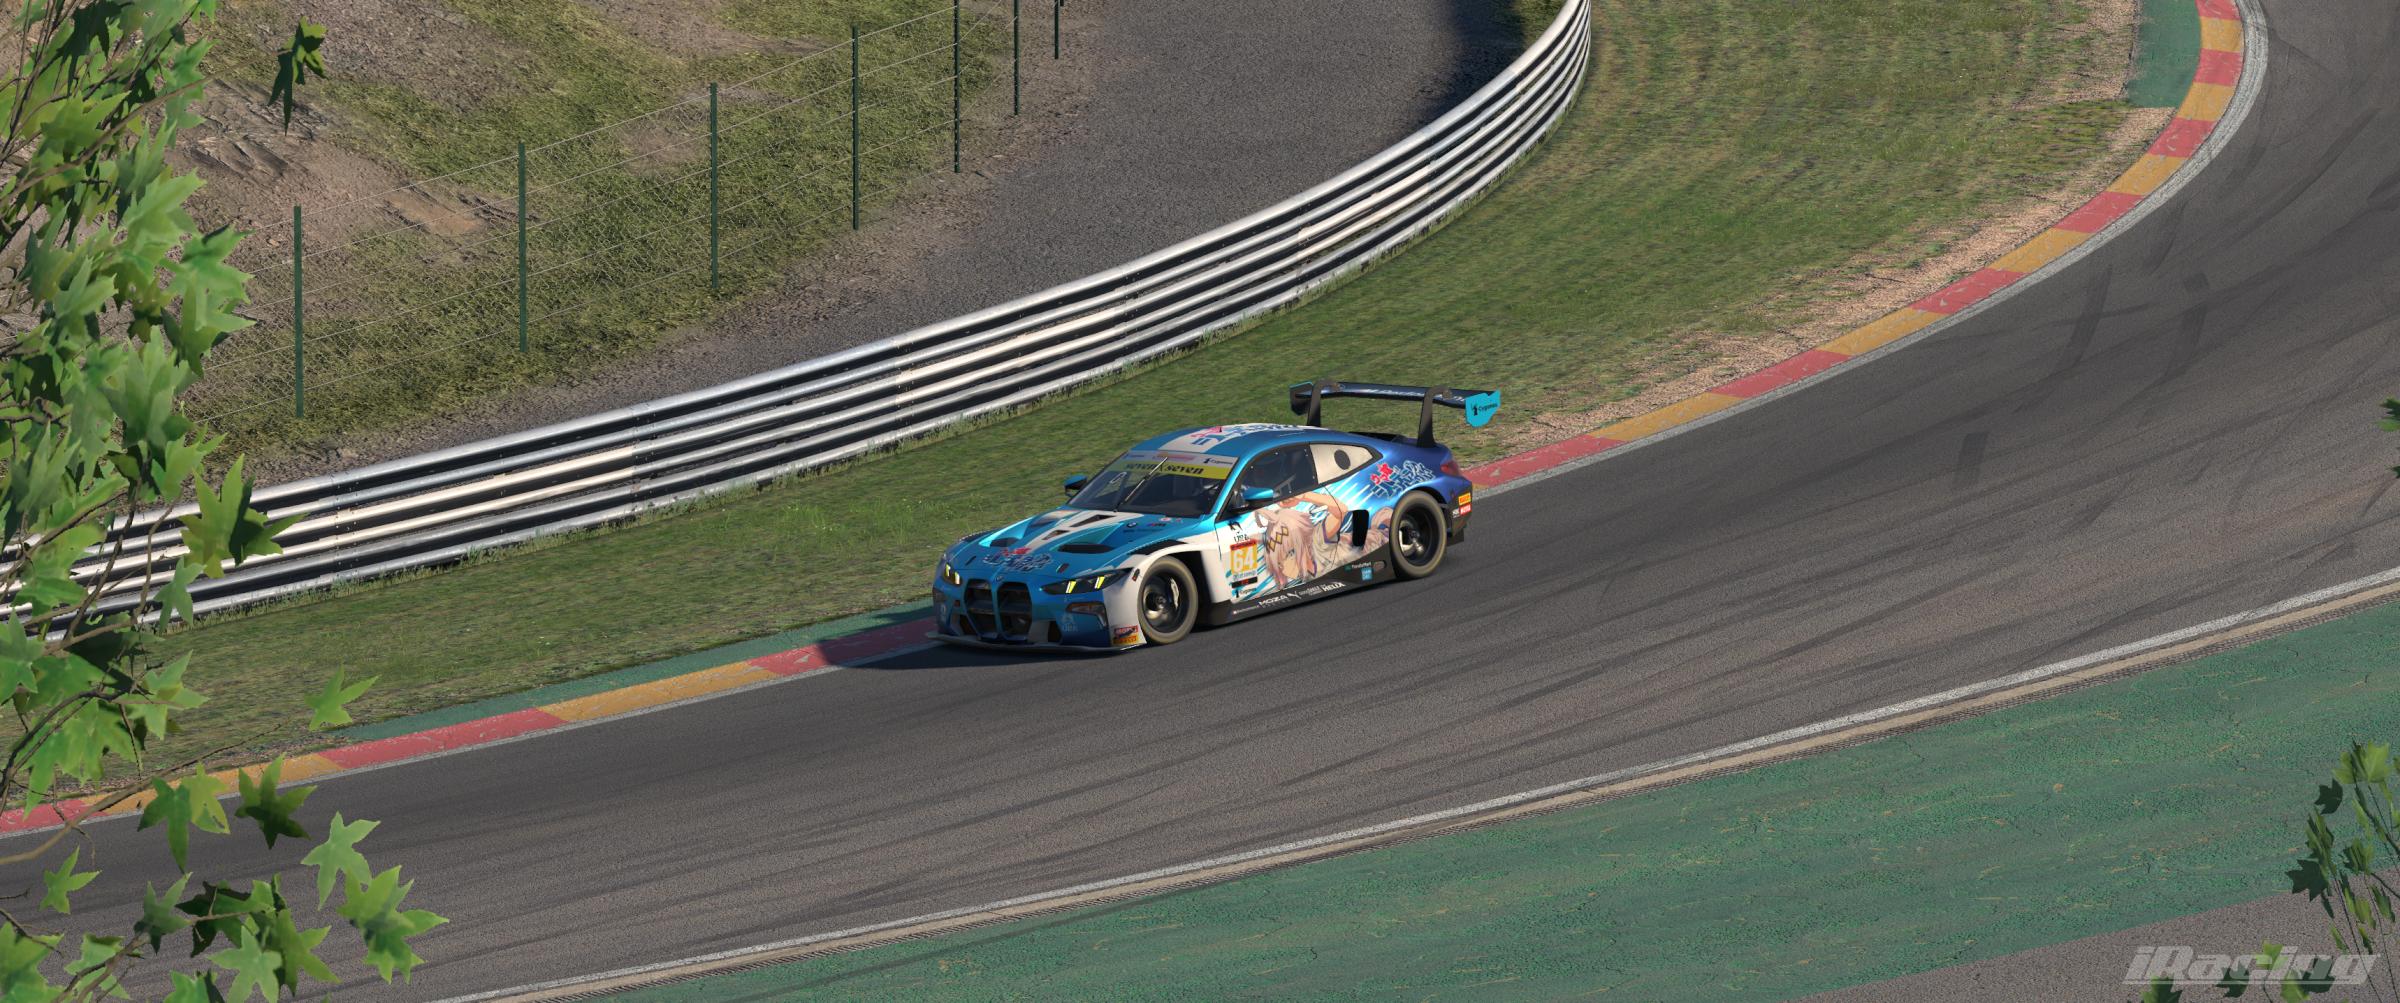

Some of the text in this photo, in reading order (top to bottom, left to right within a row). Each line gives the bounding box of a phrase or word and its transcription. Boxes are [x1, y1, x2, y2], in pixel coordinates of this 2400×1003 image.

[1166, 464, 1204, 474] seven
[1233, 546, 1255, 573] 64
[1258, 594, 1288, 606] MOZA
